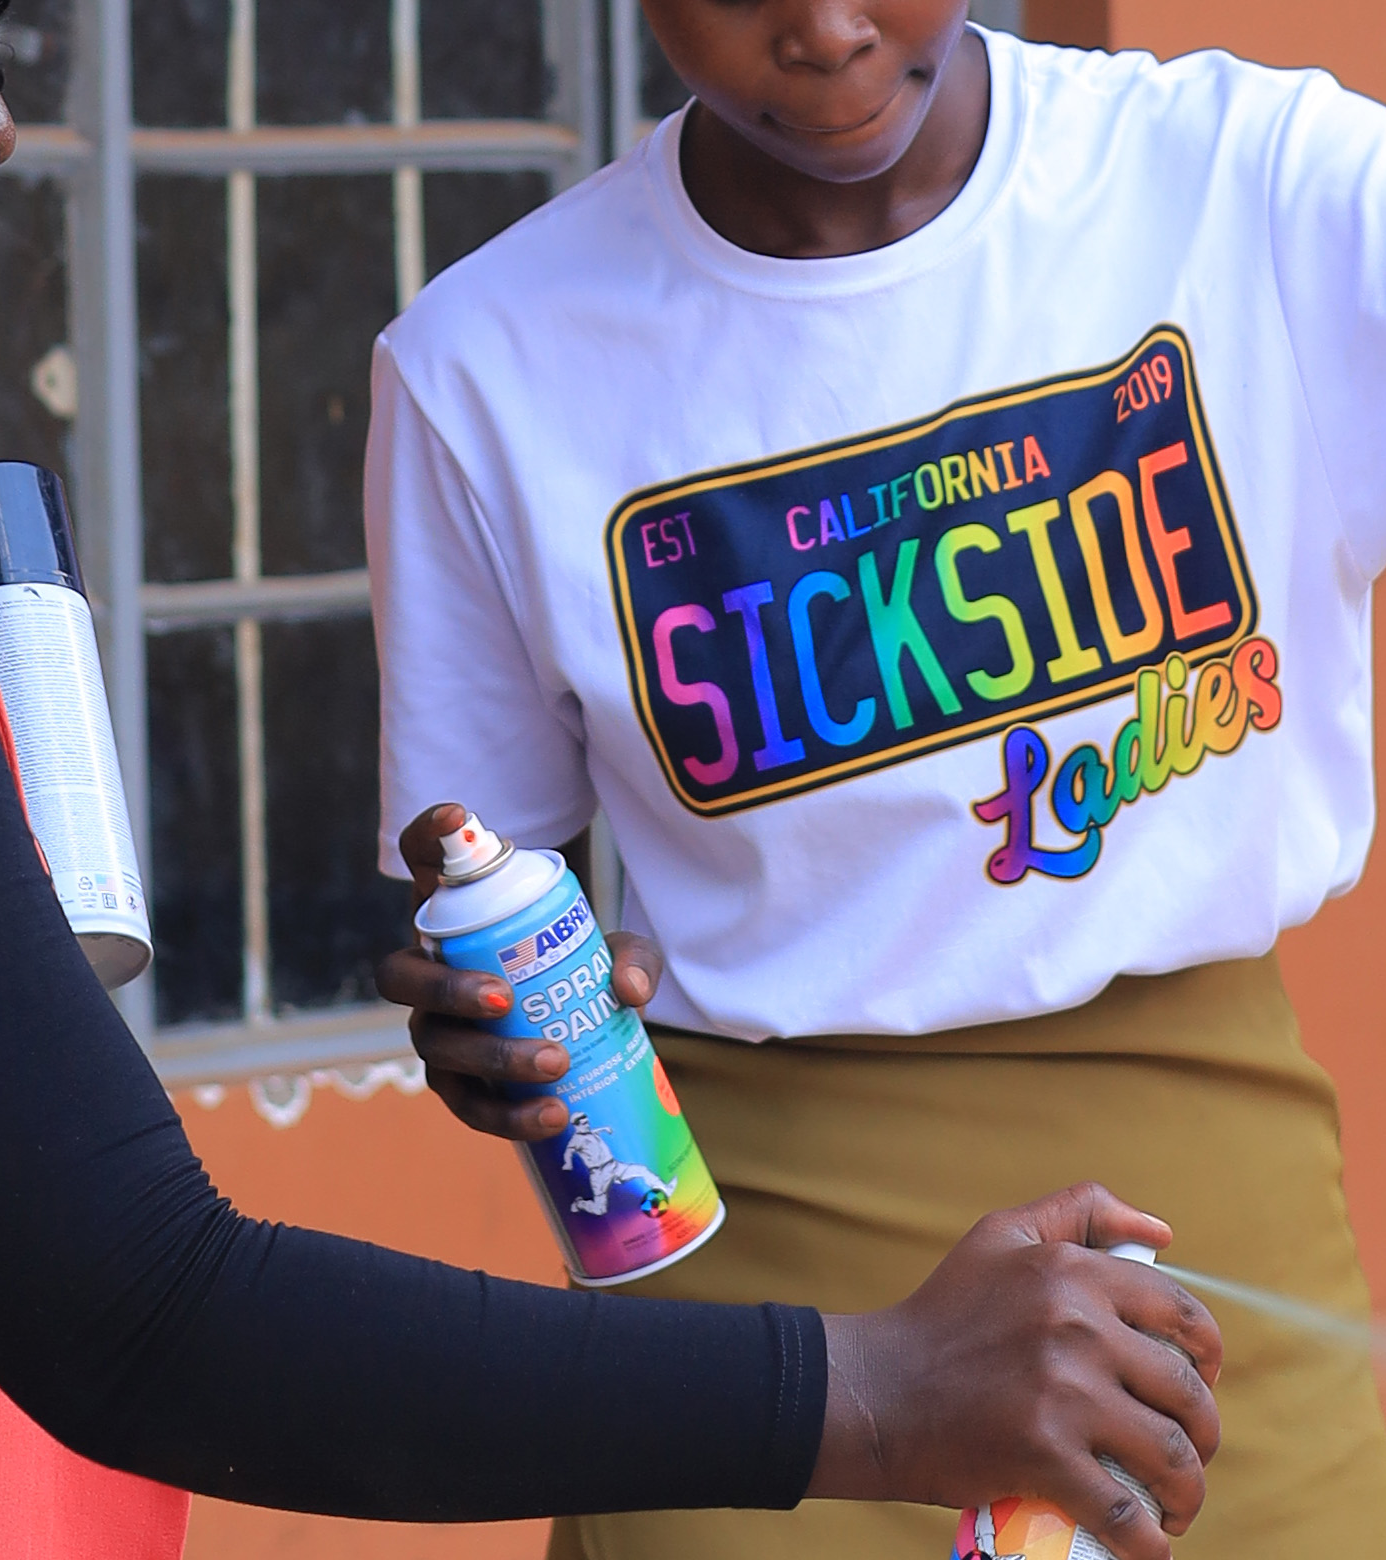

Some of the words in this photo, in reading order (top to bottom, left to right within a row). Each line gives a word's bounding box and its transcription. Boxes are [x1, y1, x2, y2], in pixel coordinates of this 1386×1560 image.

[640, 512, 699, 568] EST
[785, 436, 1052, 552] CALIFORNIA
[1113, 354, 1175, 424] 2019
[651, 440, 1233, 788] SICKSIDE
[974, 637, 1282, 885] Ladies
[541, 990, 621, 1043] PAIN
[578, 1051, 623, 1085] PURPOSE
[568, 1072, 619, 1104] INTERIOR
